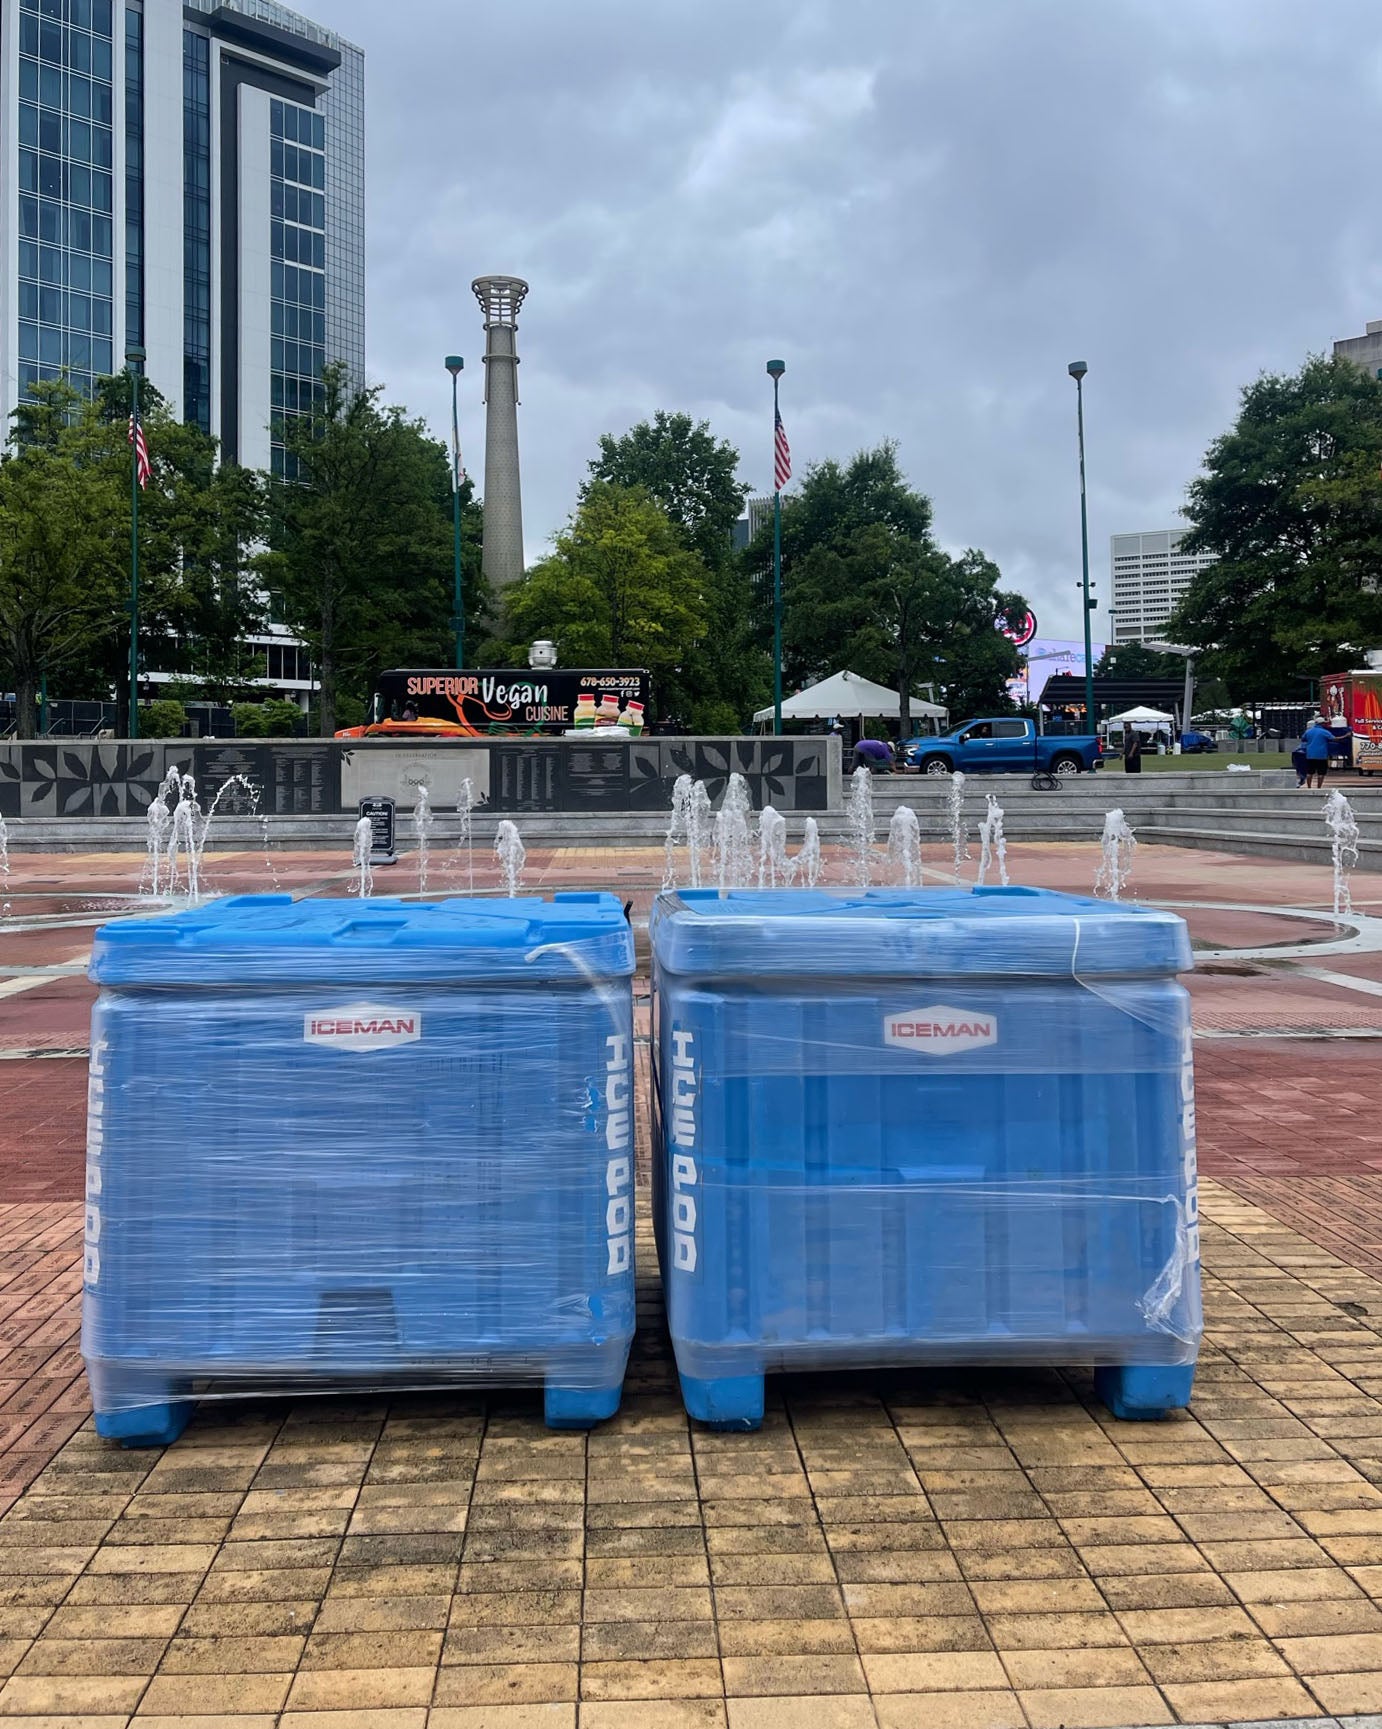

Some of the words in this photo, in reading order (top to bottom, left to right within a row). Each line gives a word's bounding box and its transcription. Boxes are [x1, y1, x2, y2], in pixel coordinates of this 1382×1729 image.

[580, 677, 640, 687] 678-650-3923
[407, 677, 479, 695] SUPERIOR
[482, 676, 548, 709] Vegan
[526, 705, 569, 721] CUISINE
[311, 1019, 415, 1035] ICEMAN
[891, 1023, 991, 1037] ICEMAN
